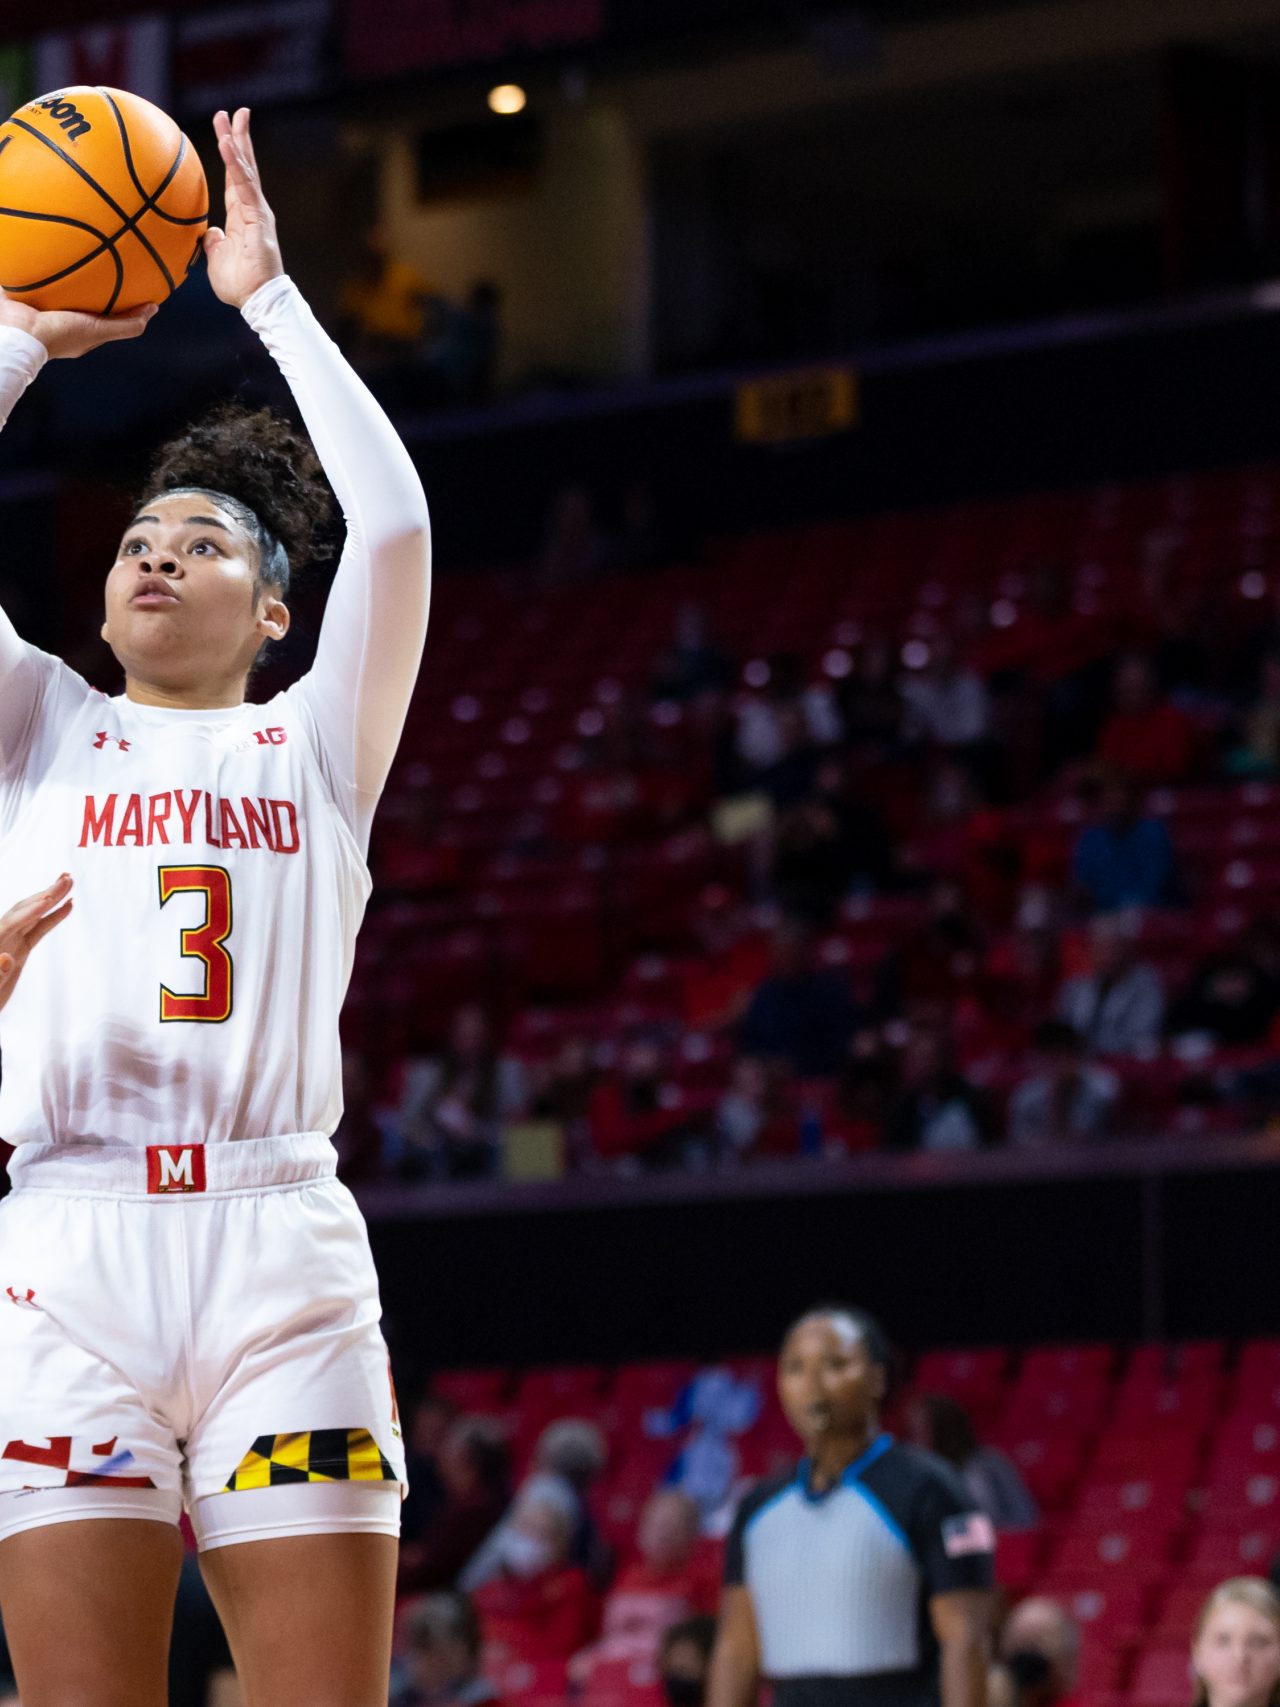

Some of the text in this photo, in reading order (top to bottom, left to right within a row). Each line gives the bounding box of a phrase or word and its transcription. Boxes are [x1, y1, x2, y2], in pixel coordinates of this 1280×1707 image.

[77, 789, 299, 854] MARYLAND
[157, 864, 234, 1023] 3
[158, 1149, 195, 1187] M
